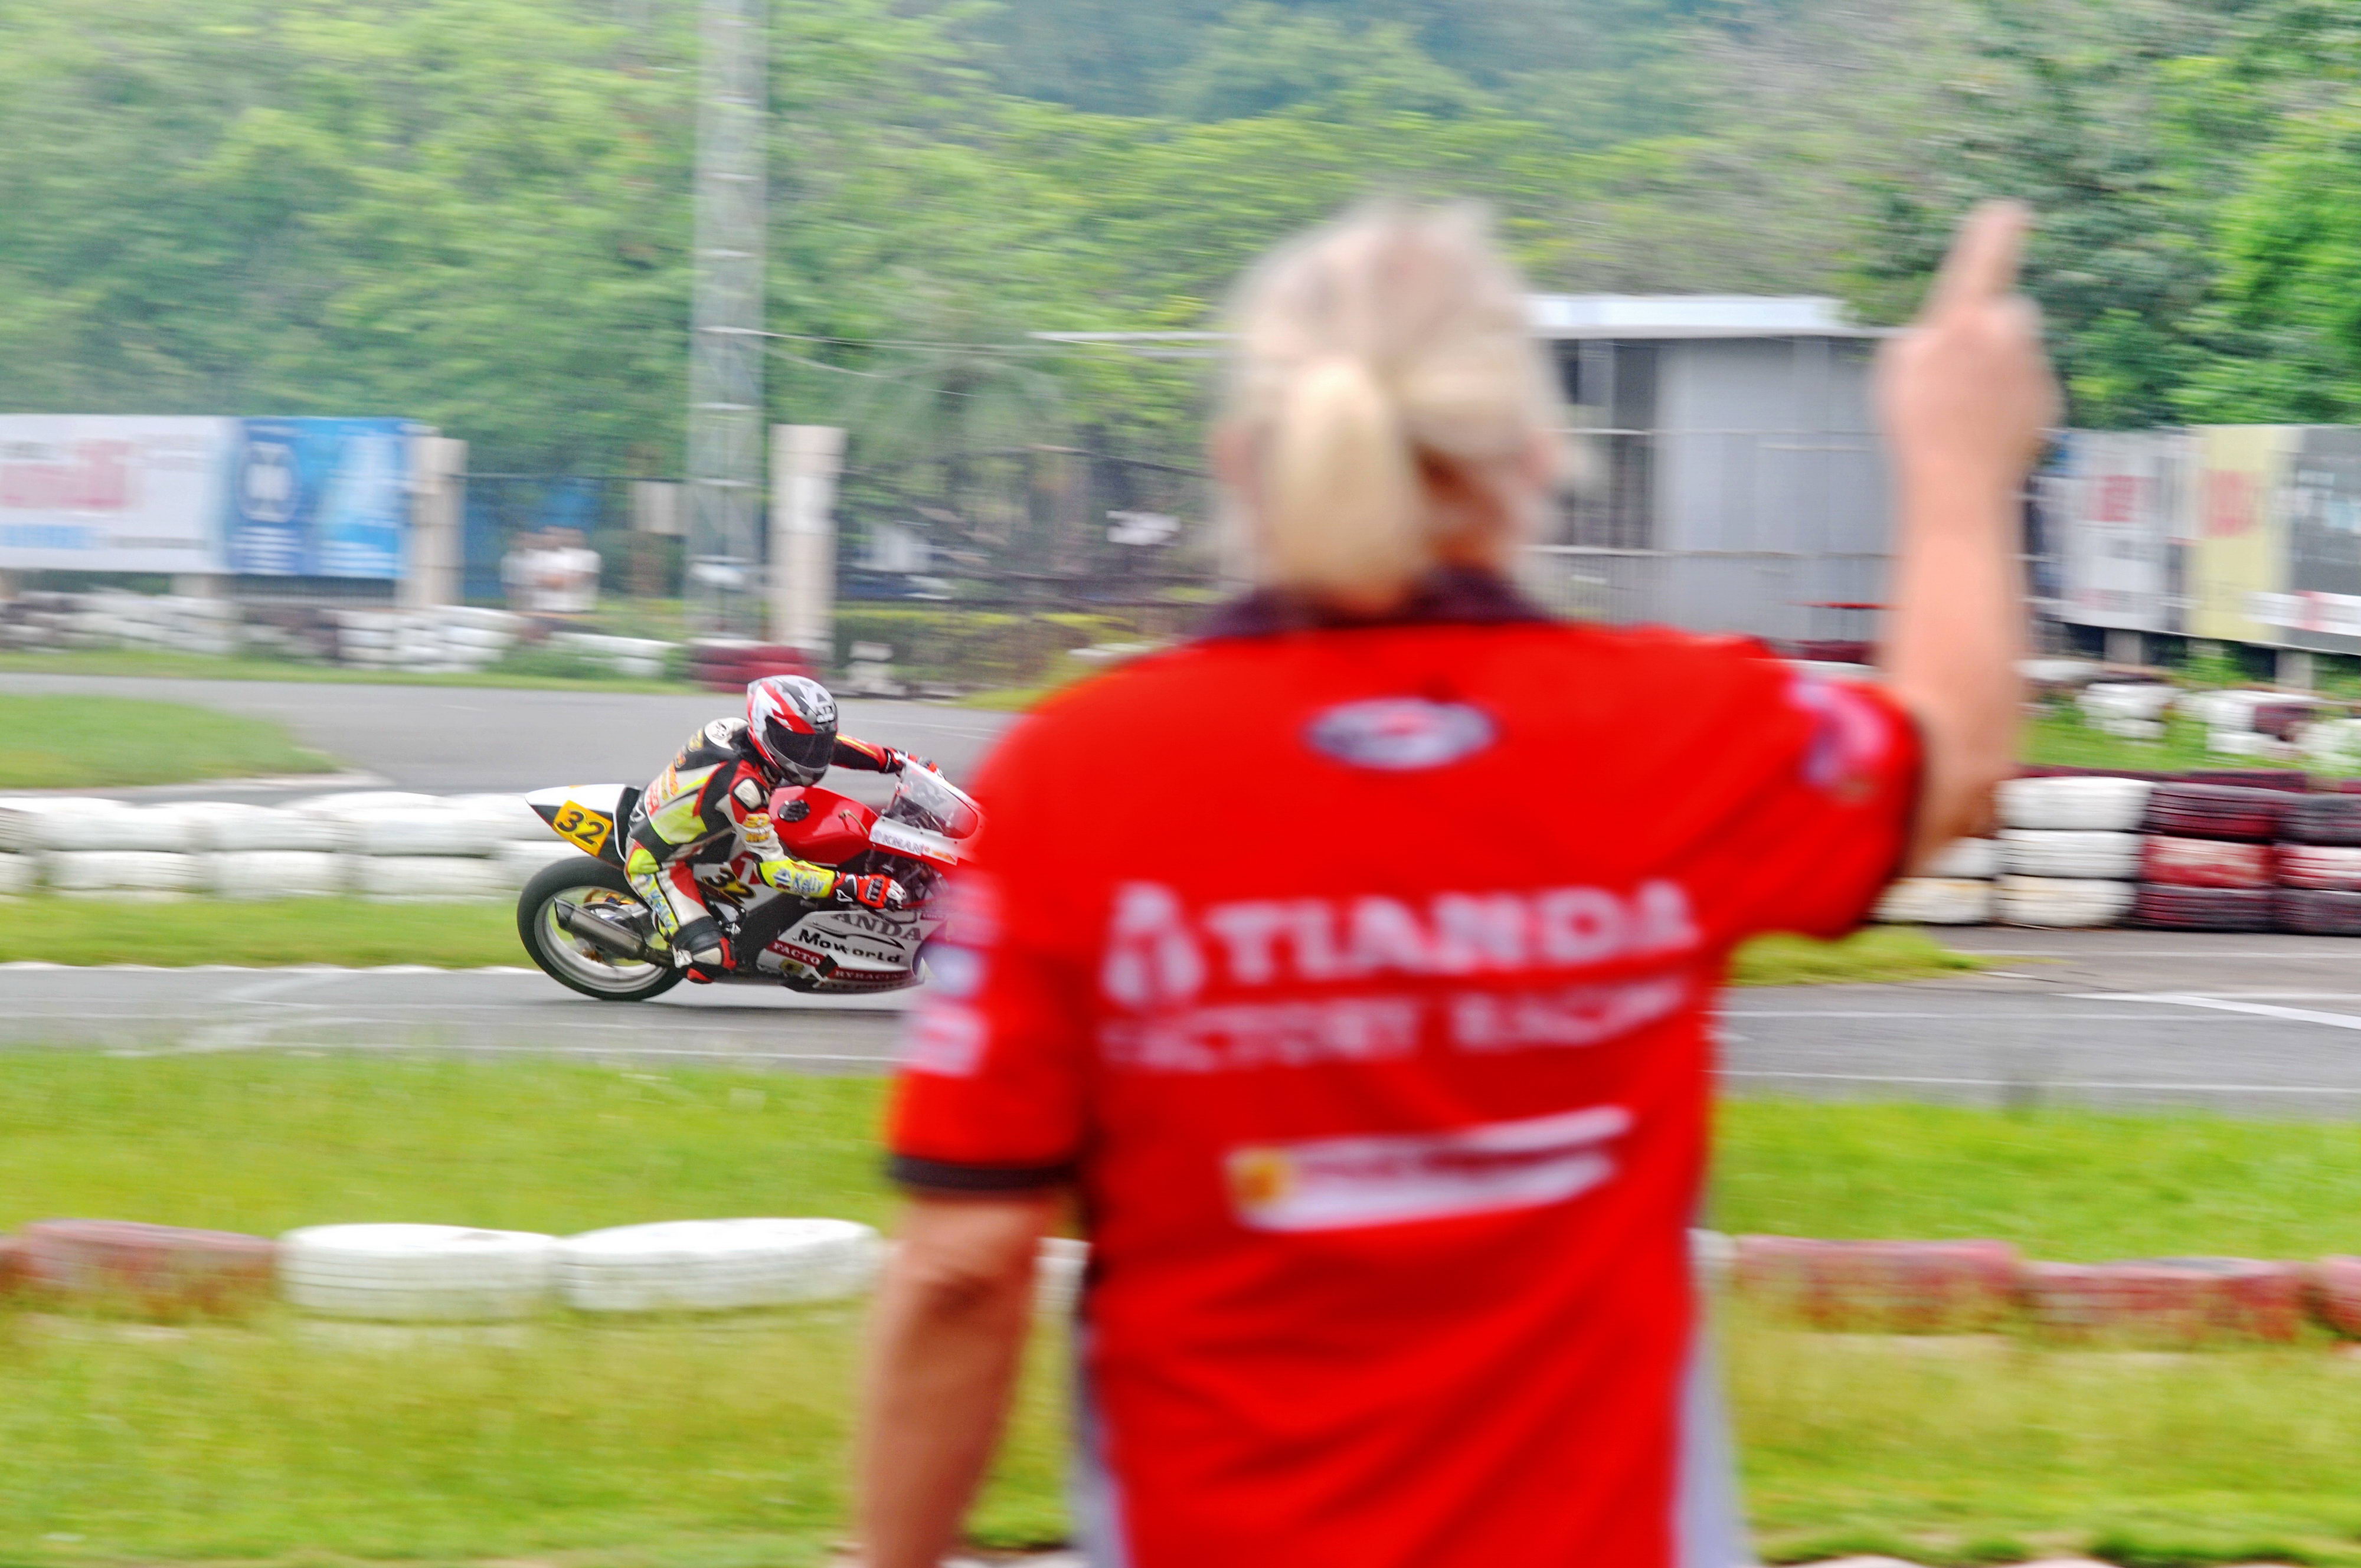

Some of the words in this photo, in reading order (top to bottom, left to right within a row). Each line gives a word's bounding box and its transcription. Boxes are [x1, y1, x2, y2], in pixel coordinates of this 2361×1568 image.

[555, 810, 606, 846] 32
[701, 866, 757, 905] 32
[792, 872, 825, 894] Kelly
[1204, 882, 1703, 984] TIANDA
